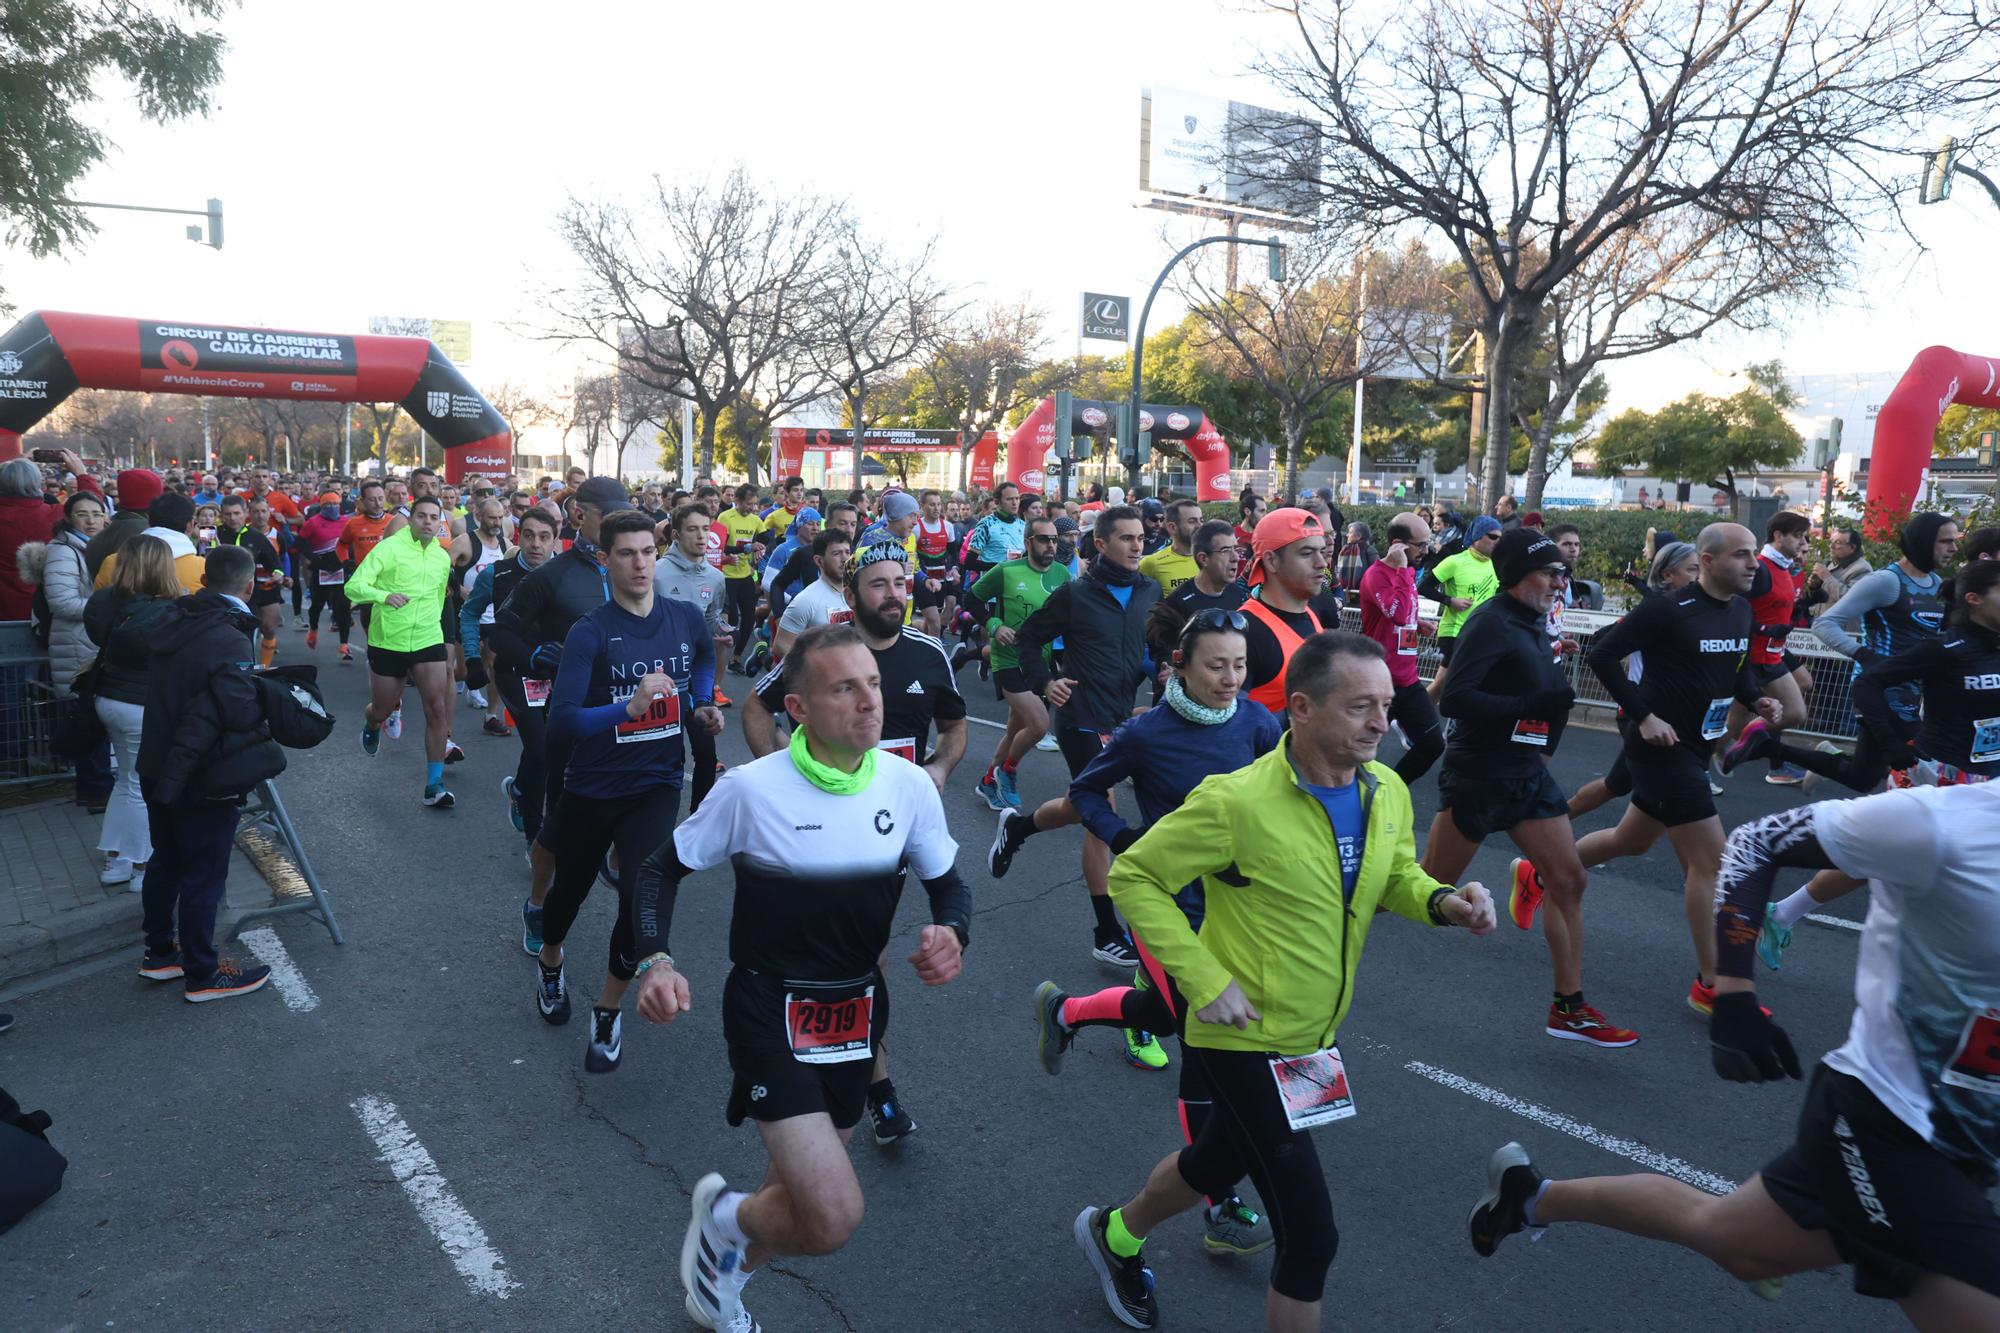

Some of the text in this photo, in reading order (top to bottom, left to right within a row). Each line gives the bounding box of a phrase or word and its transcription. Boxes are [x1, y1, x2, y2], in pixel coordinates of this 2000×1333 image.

[156, 326, 339, 349] CIRCUIT DE CARRERES
[1086, 325, 1126, 336] LEXUS
[163, 374, 265, 389] #ValènciaCorre
[1700, 638, 1749, 652] REDOLAT
[1805, 643, 1818, 651] DEL
[611, 655, 689, 680] NORTE
[800, 1004, 857, 1034] 2919
[1840, 1141, 1893, 1229] TERREX
